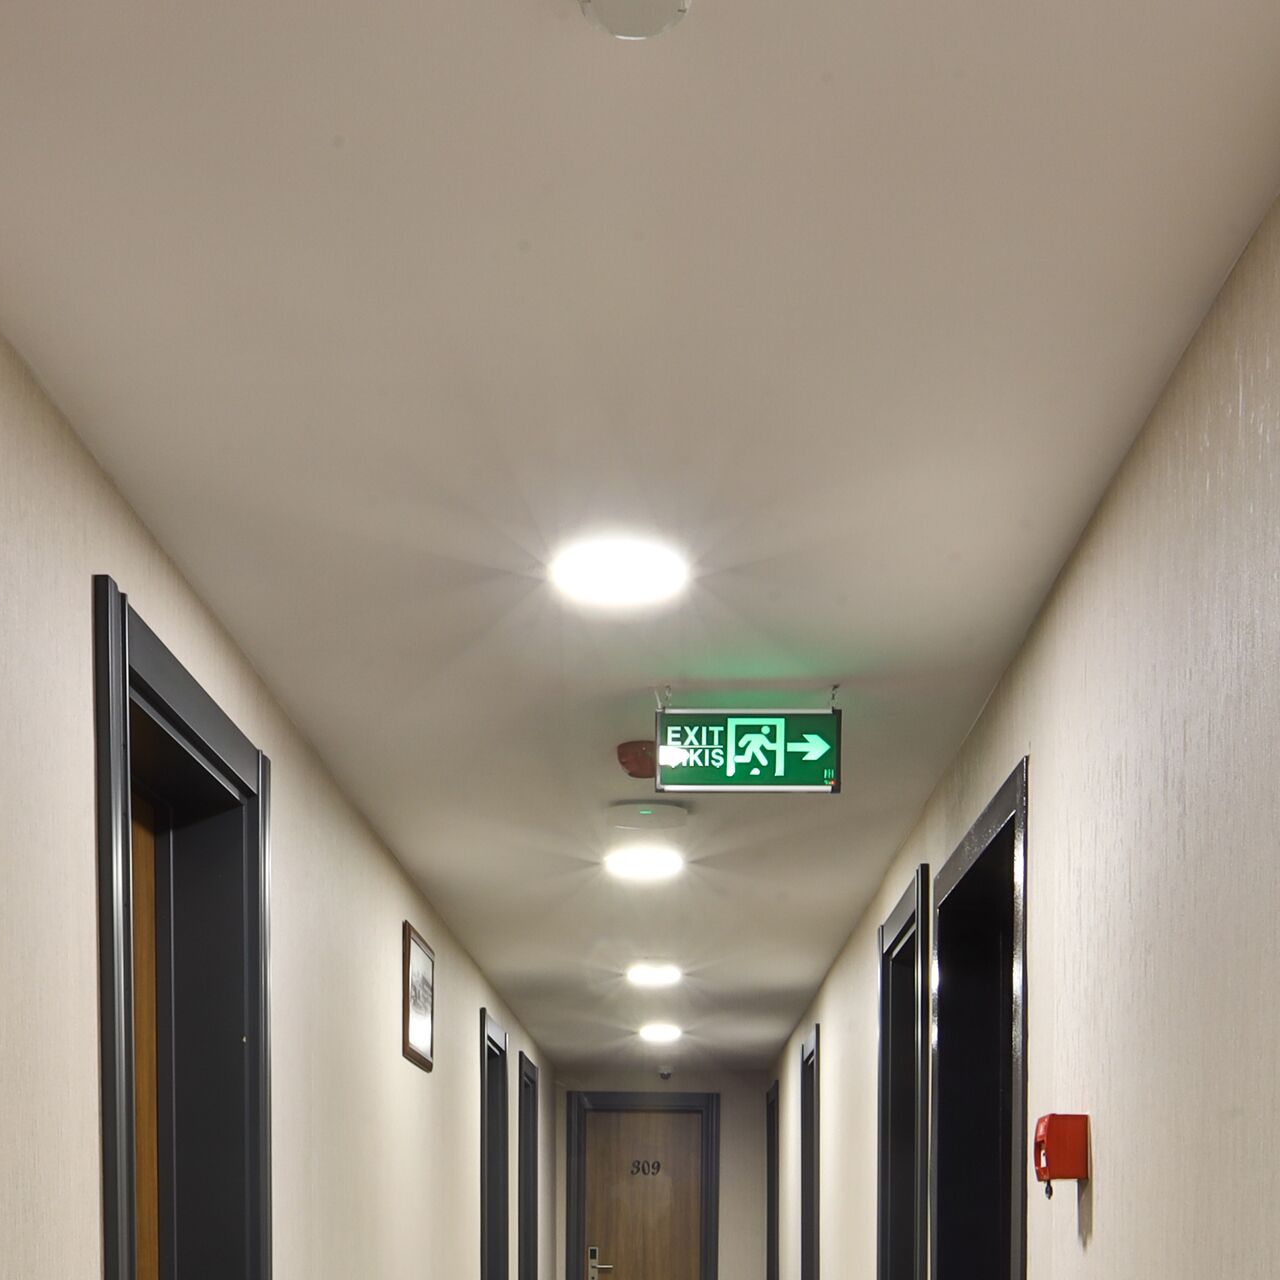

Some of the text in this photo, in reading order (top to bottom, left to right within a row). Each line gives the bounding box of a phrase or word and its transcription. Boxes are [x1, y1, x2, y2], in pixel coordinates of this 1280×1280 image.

[667, 726, 724, 746] EXIT
[667, 748, 724, 768] KIŞ
[630, 1159, 661, 1176] 309
